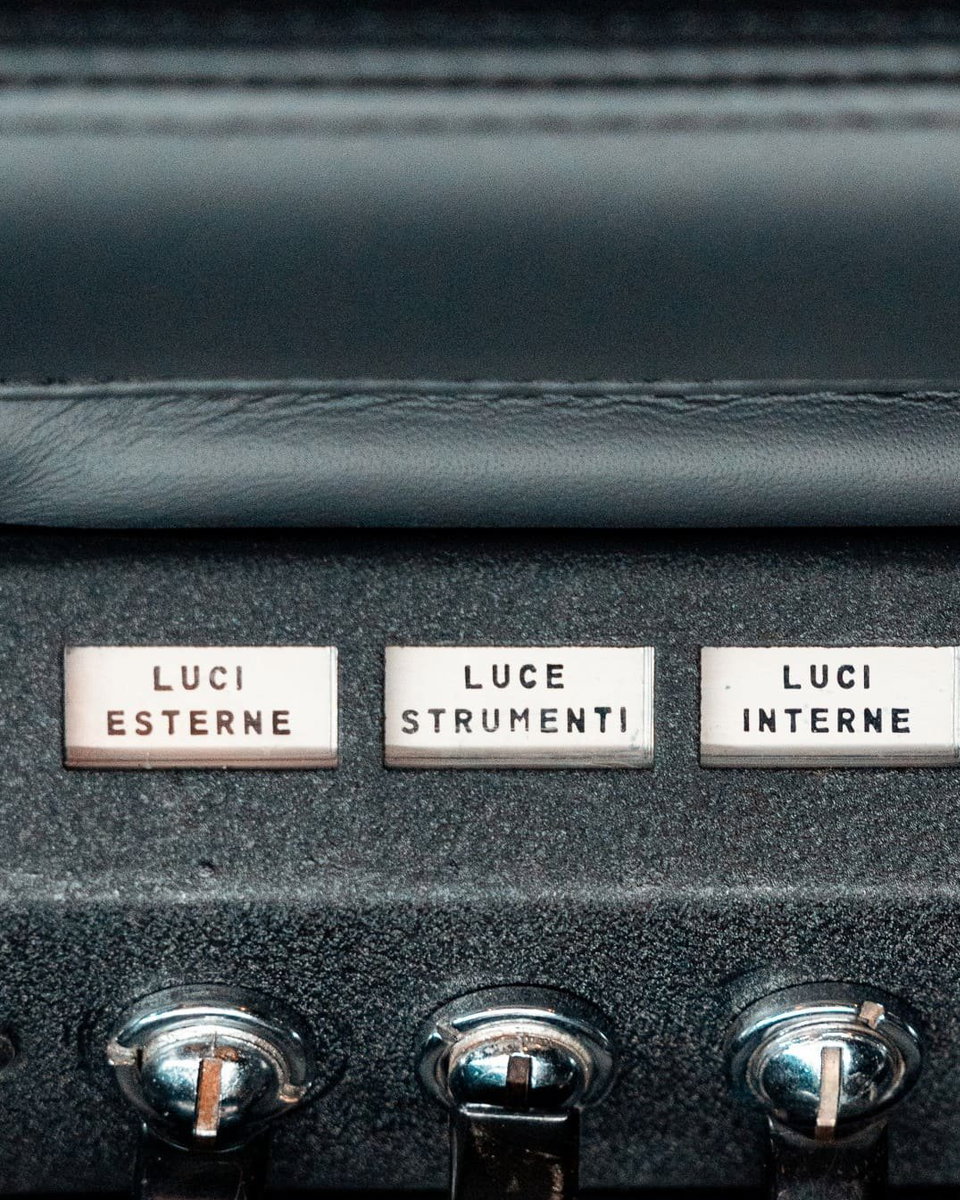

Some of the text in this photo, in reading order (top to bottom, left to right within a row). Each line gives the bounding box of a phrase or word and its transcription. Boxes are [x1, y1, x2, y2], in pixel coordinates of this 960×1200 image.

[152, 665, 244, 692] LUCI
[464, 663, 565, 690] LUCE
[782, 664, 871, 690] LUCI
[106, 709, 292, 736] ESTERNE
[401, 706, 628, 734] STRUMENTI
[742, 708, 910, 733] INTERNE
